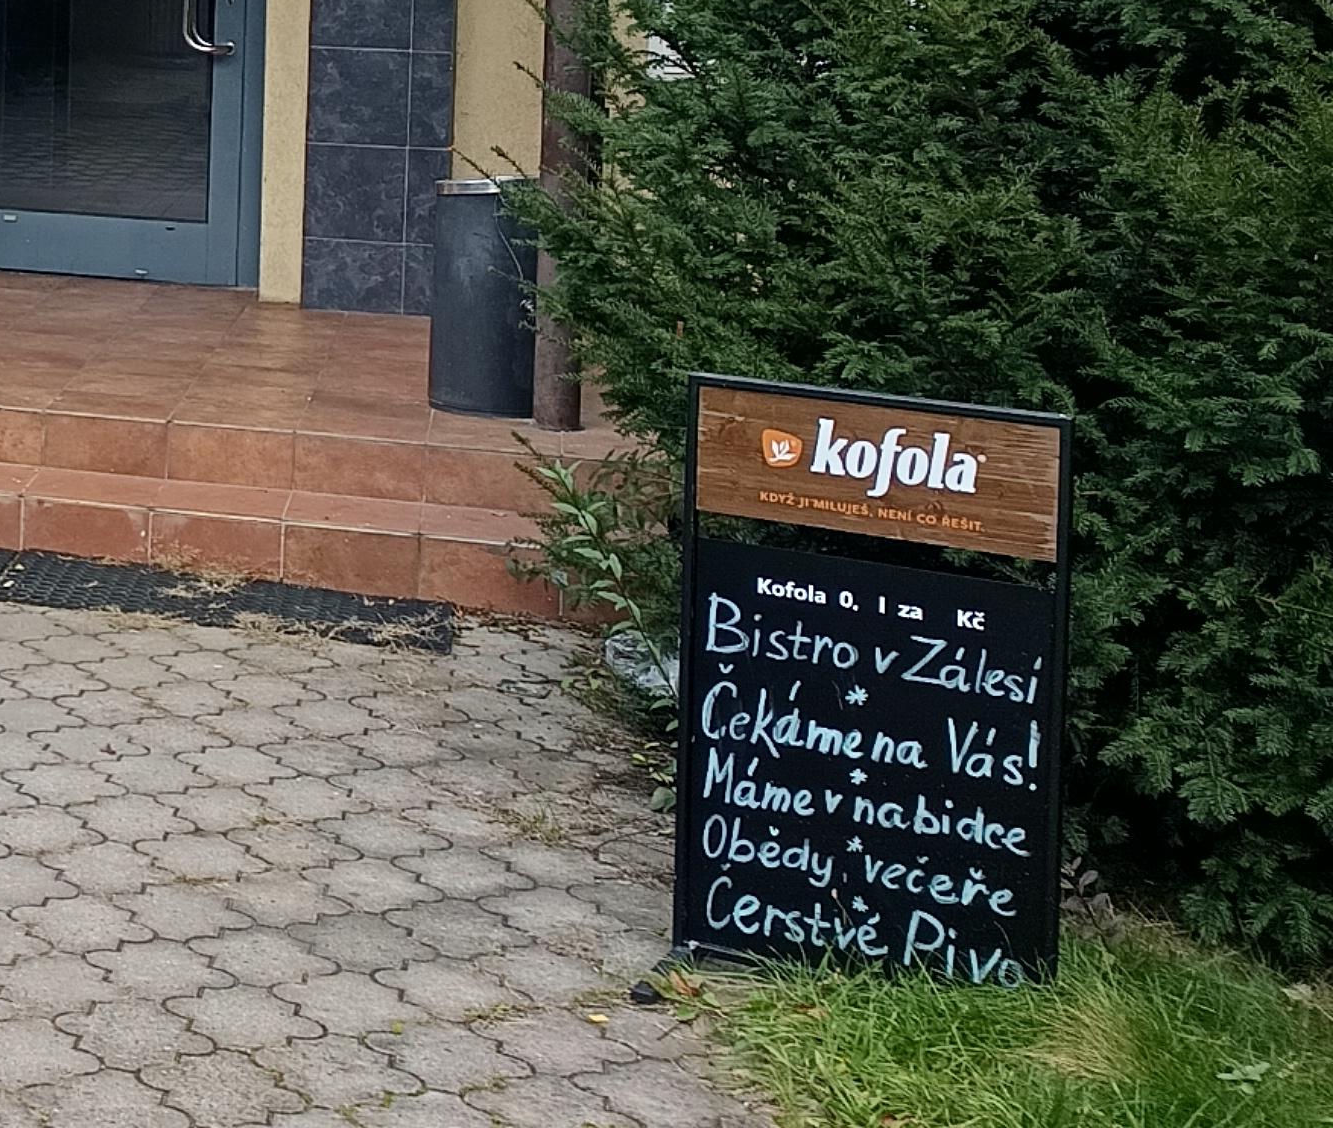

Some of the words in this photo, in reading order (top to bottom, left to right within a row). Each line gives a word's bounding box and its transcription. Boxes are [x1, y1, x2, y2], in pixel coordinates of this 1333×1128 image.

[810, 417, 976, 497] kofola
[759, 491, 796, 506] KDYŽ
[878, 508, 913, 522] NENÍ
[916, 513, 937, 524] CO
[705, 592, 859, 669] Bistro
[756, 577, 826, 604] Kofola
[897, 603, 924, 621] za
[956, 609, 986, 631] Kč
[701, 662, 864, 759] Čekáme
[871, 731, 928, 770] na
[947, 716, 1041, 791] Vás!
[703, 747, 815, 816] Máme
[864, 854, 1017, 917] večeře
[902, 909, 1024, 988] Pivo
